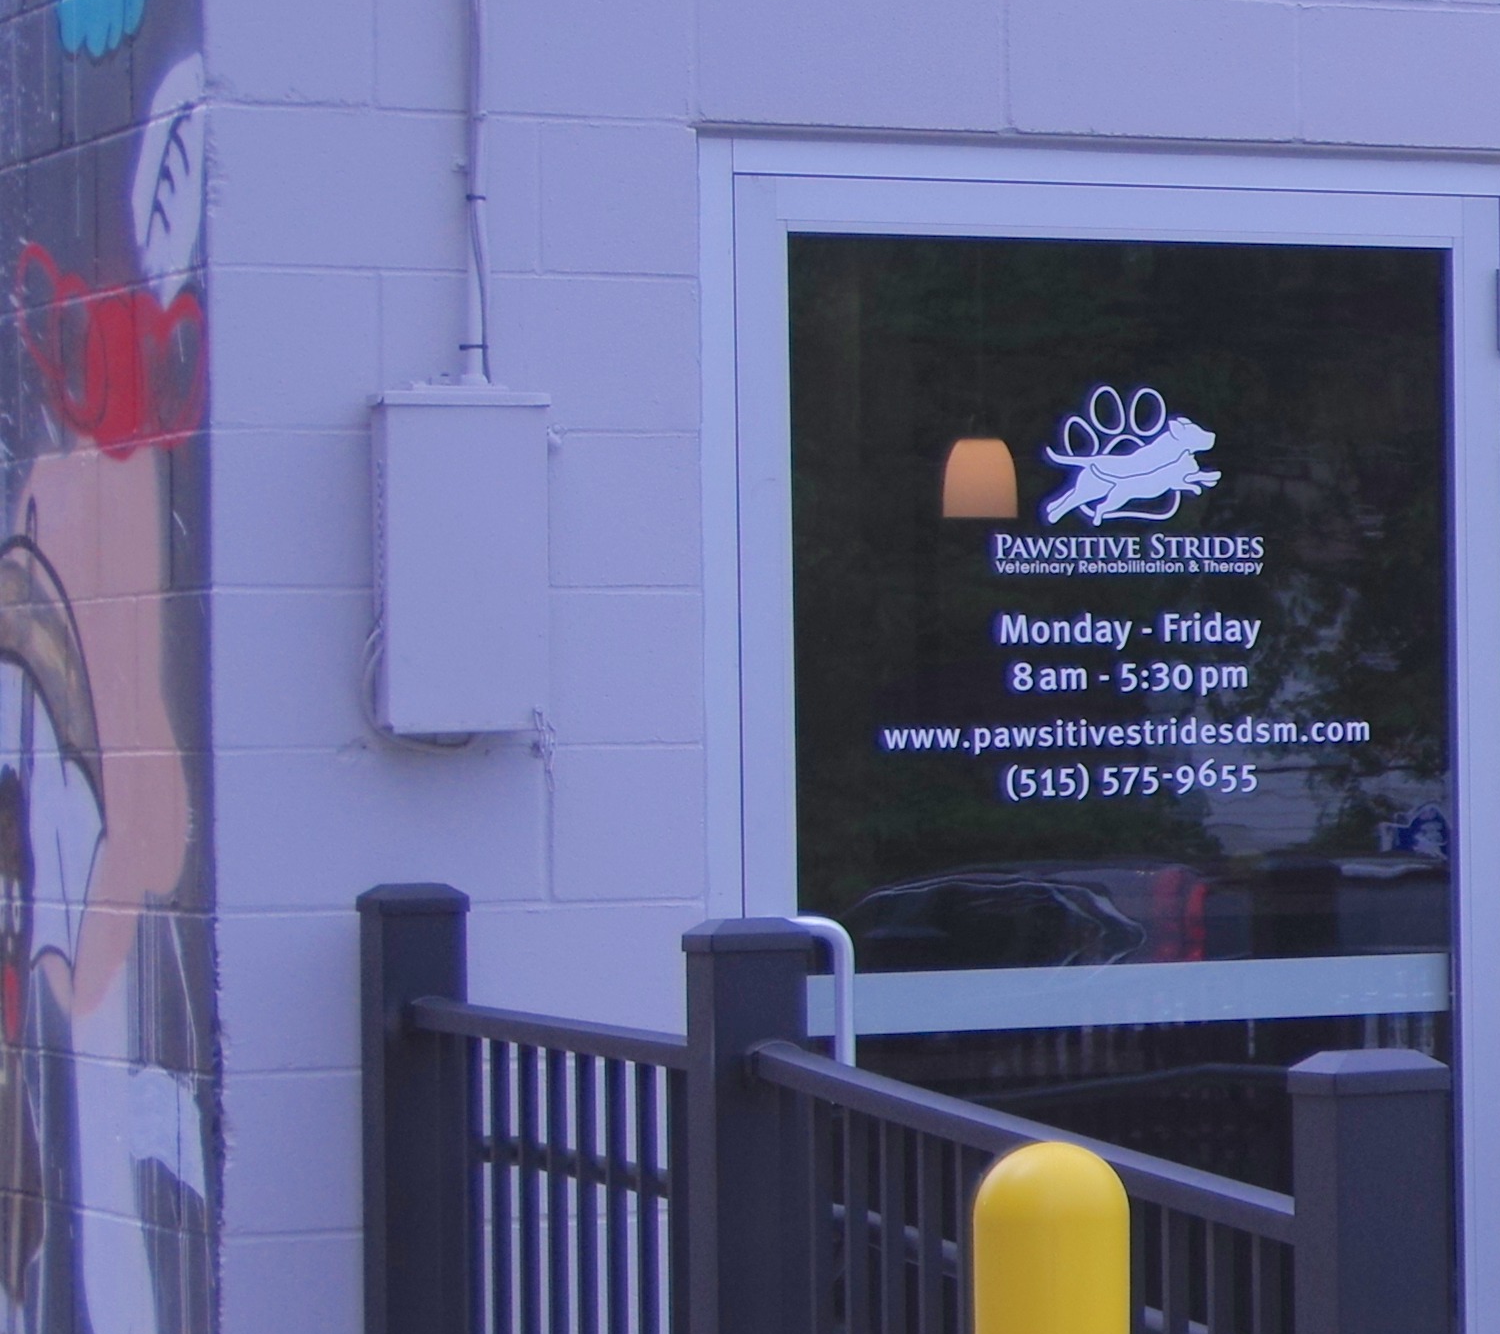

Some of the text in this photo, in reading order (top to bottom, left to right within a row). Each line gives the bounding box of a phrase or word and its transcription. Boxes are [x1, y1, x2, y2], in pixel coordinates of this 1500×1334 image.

[994, 533, 1264, 559] PAWSITIVE STRIDES
[996, 560, 1264, 576] Veterinary Rehabilitation & Therapy
[1000, 612, 1261, 651] Monday - Friday
[884, 716, 1370, 754] www.pawsitivestridesdsm.com
[1006, 758, 1258, 801] (515) 575-9655
